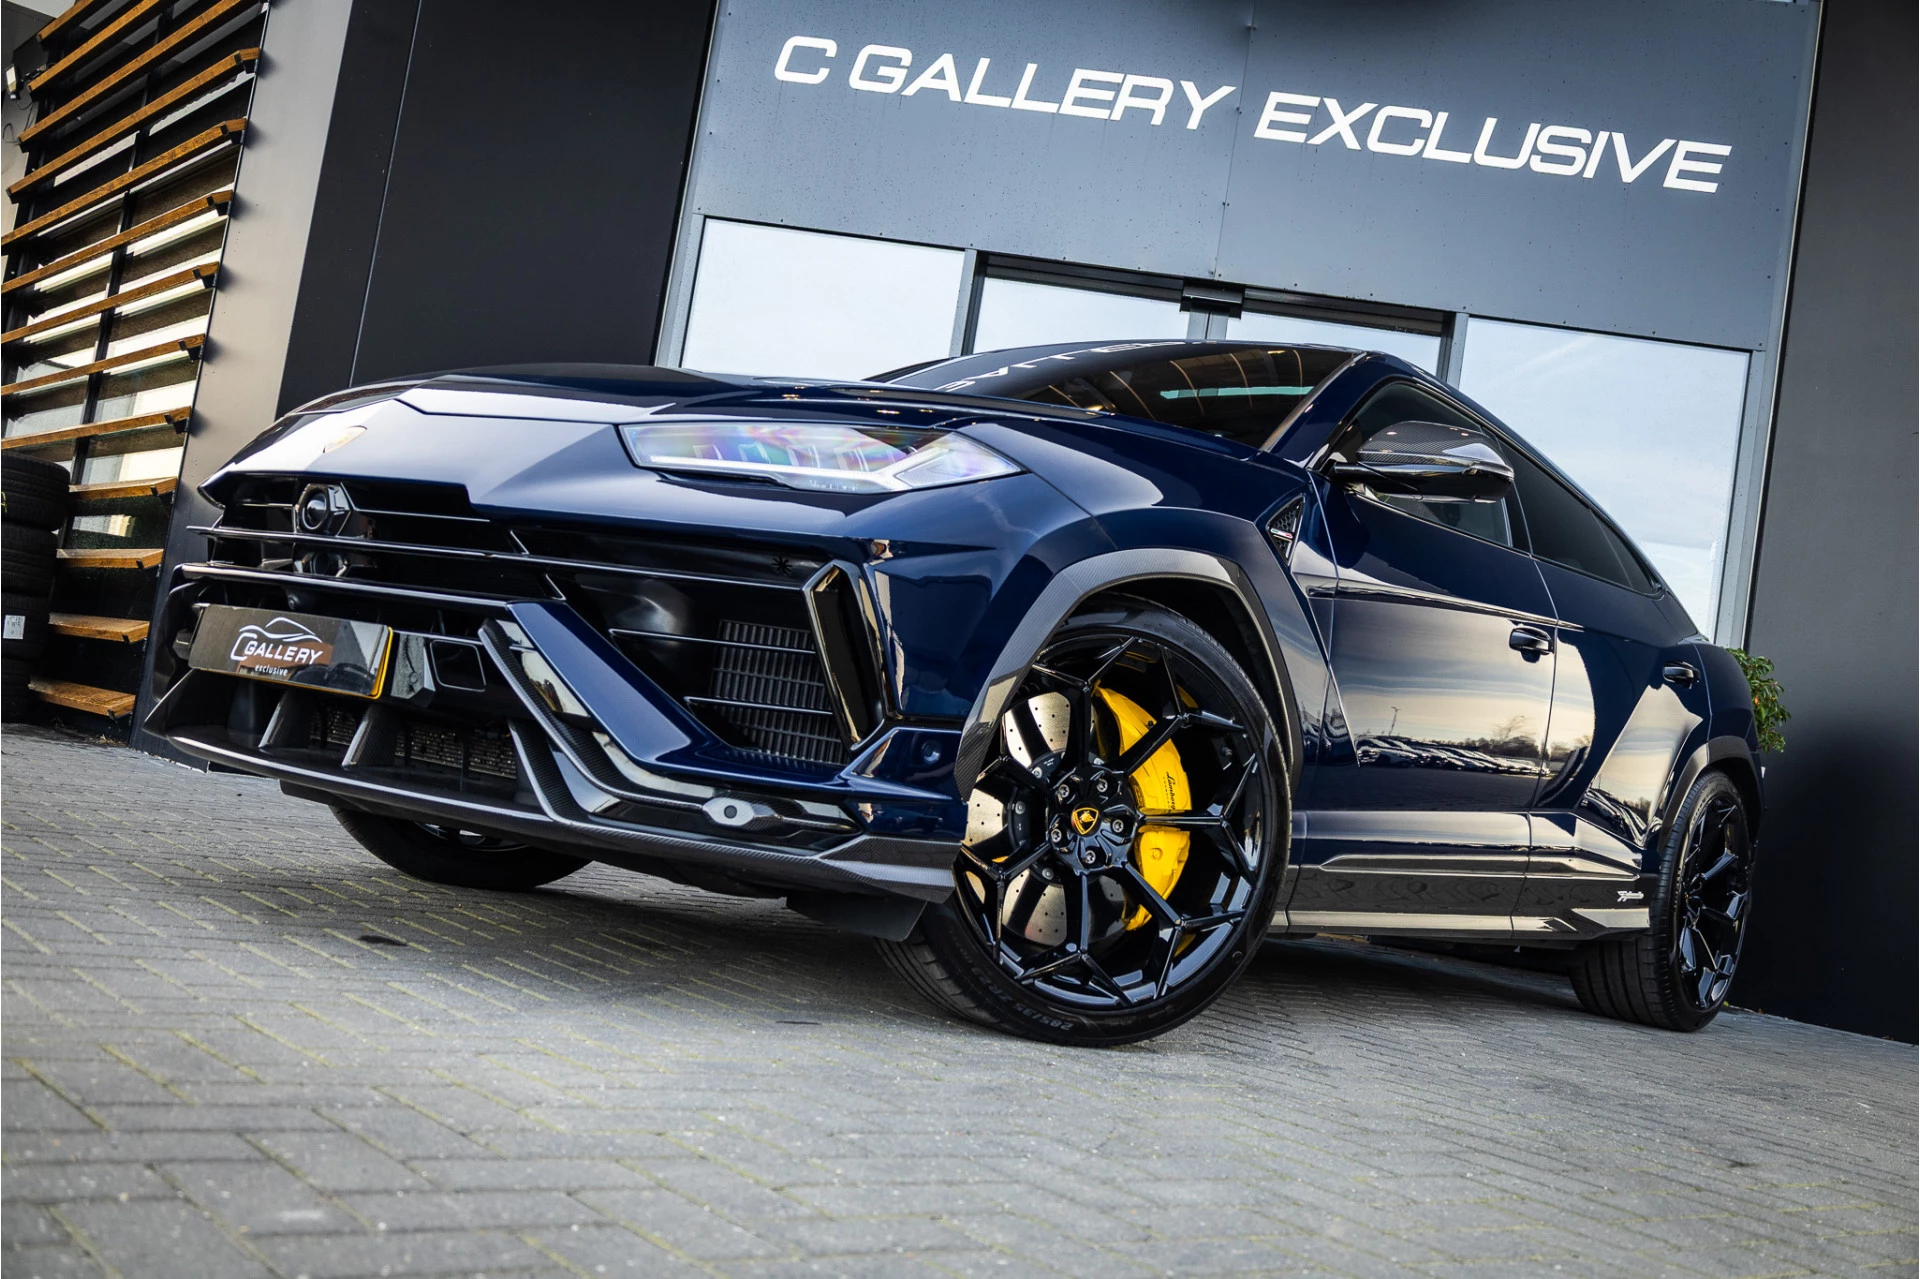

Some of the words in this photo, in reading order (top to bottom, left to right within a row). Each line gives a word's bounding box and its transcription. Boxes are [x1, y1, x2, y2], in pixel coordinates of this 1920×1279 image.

[775, 36, 837, 84] C
[849, 45, 1236, 129] GALLERY
[1254, 92, 1731, 192] EXCLUSIVE
[244, 640, 324, 665] GALLERY
[254, 664, 288, 676] exclusive
